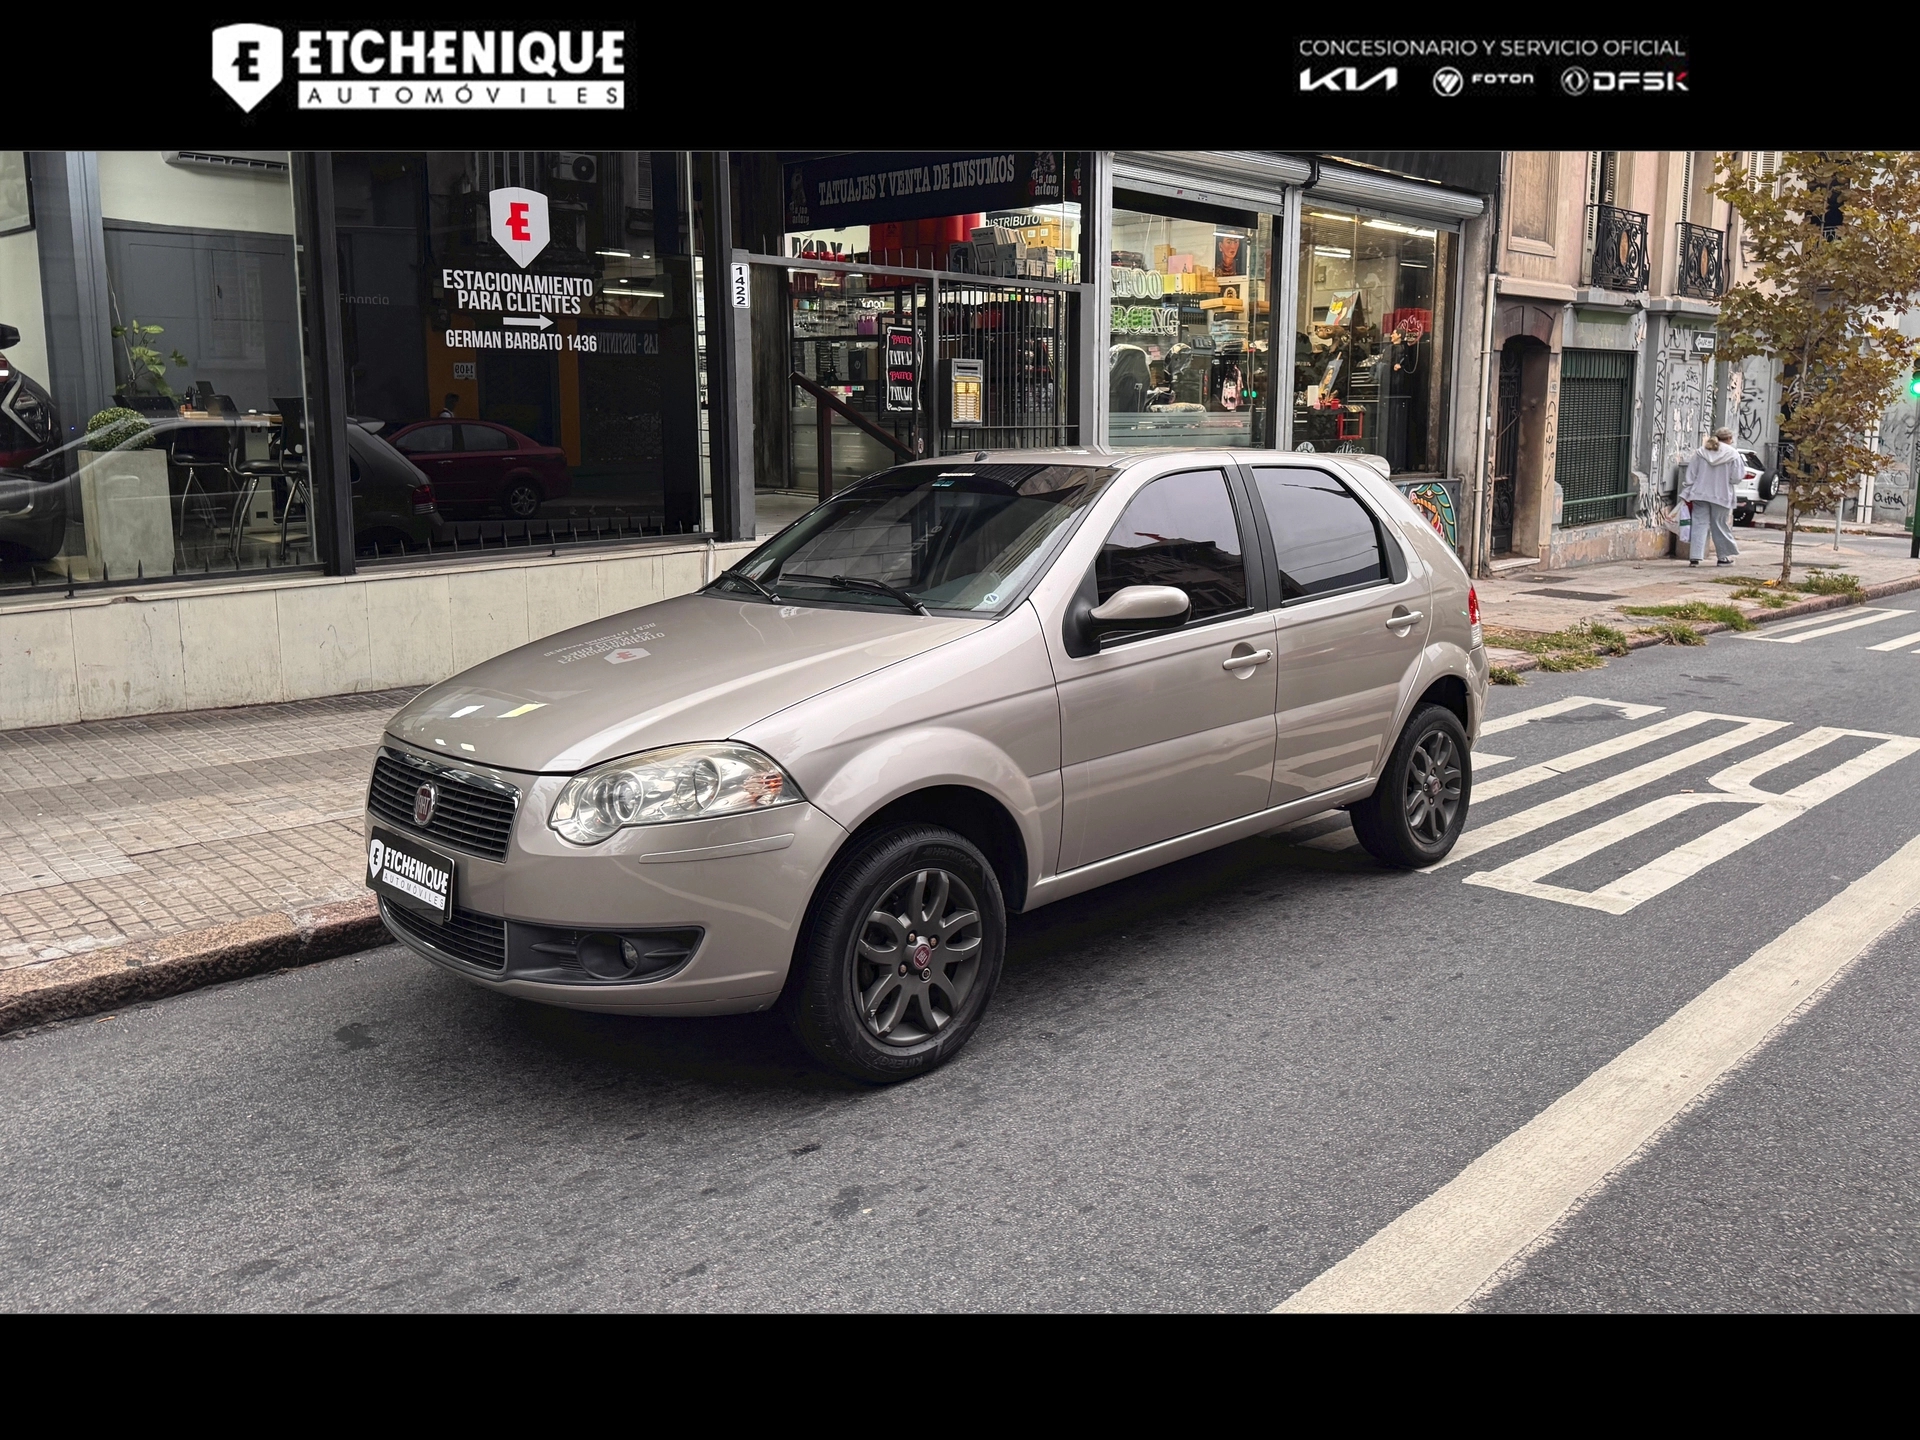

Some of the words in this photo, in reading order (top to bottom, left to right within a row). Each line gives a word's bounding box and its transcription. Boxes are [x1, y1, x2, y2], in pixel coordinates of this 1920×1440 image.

[818, 174, 876, 206] TATUAJES
[878, 172, 887, 198] Y
[888, 166, 931, 197] VENTA
[932, 163, 950, 191] DE
[953, 154, 1015, 188] INSUMOS
[442, 268, 593, 297] ESTACIONAMIENTO
[457, 290, 502, 311] PARA
[506, 293, 581, 315] CLIENTES
[445, 329, 502, 349] GERMAN
[504, 331, 563, 351] BARBATO
[566, 334, 597, 352] 1436
[384, 846, 449, 894] ETCHENIQUE
